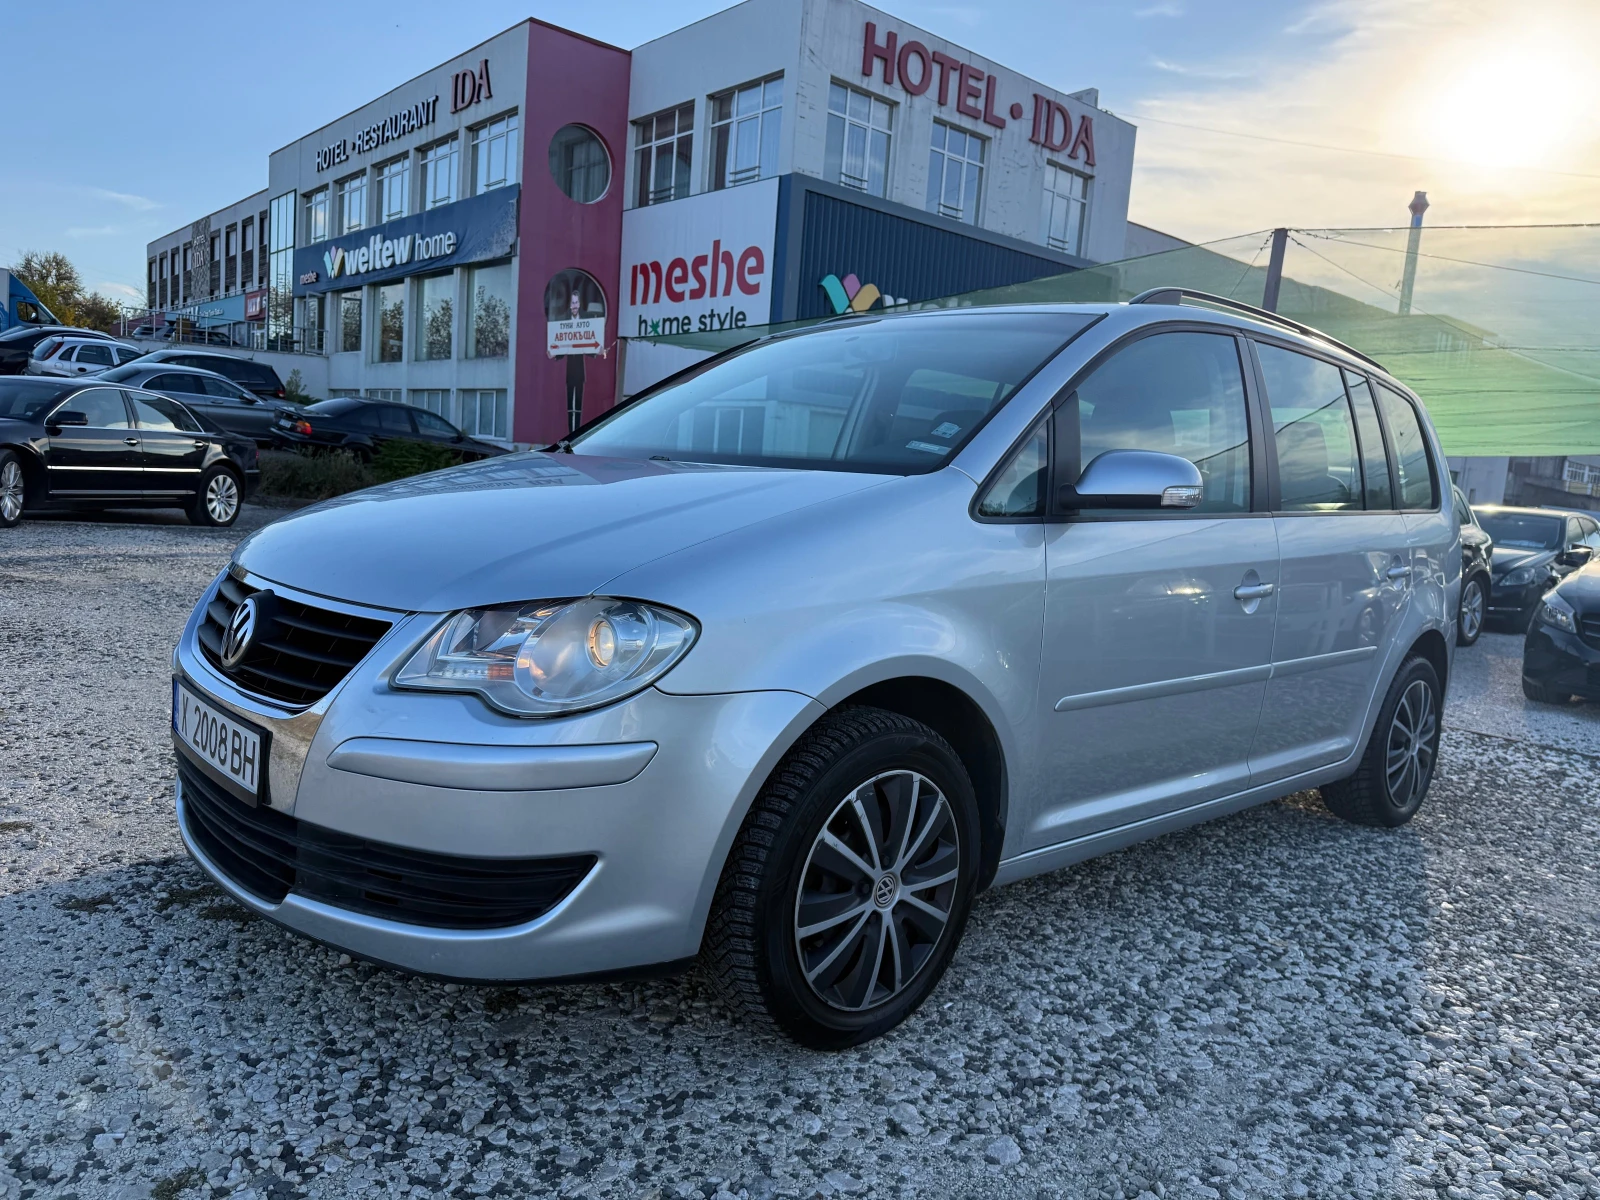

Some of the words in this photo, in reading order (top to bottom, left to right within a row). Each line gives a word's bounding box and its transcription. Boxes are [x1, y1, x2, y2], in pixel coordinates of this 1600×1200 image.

[316, 138, 349, 172] HOTEL
[355, 95, 438, 154] RESTAURANT
[450, 58, 492, 114] IDA
[862, 21, 1006, 129] HOTEL
[1029, 93, 1096, 166] IDA
[344, 234, 413, 276] weltew
[414, 231, 456, 260] home
[630, 239, 764, 306] meshe
[638, 314, 692, 336] hme
[698, 306, 747, 332] style
